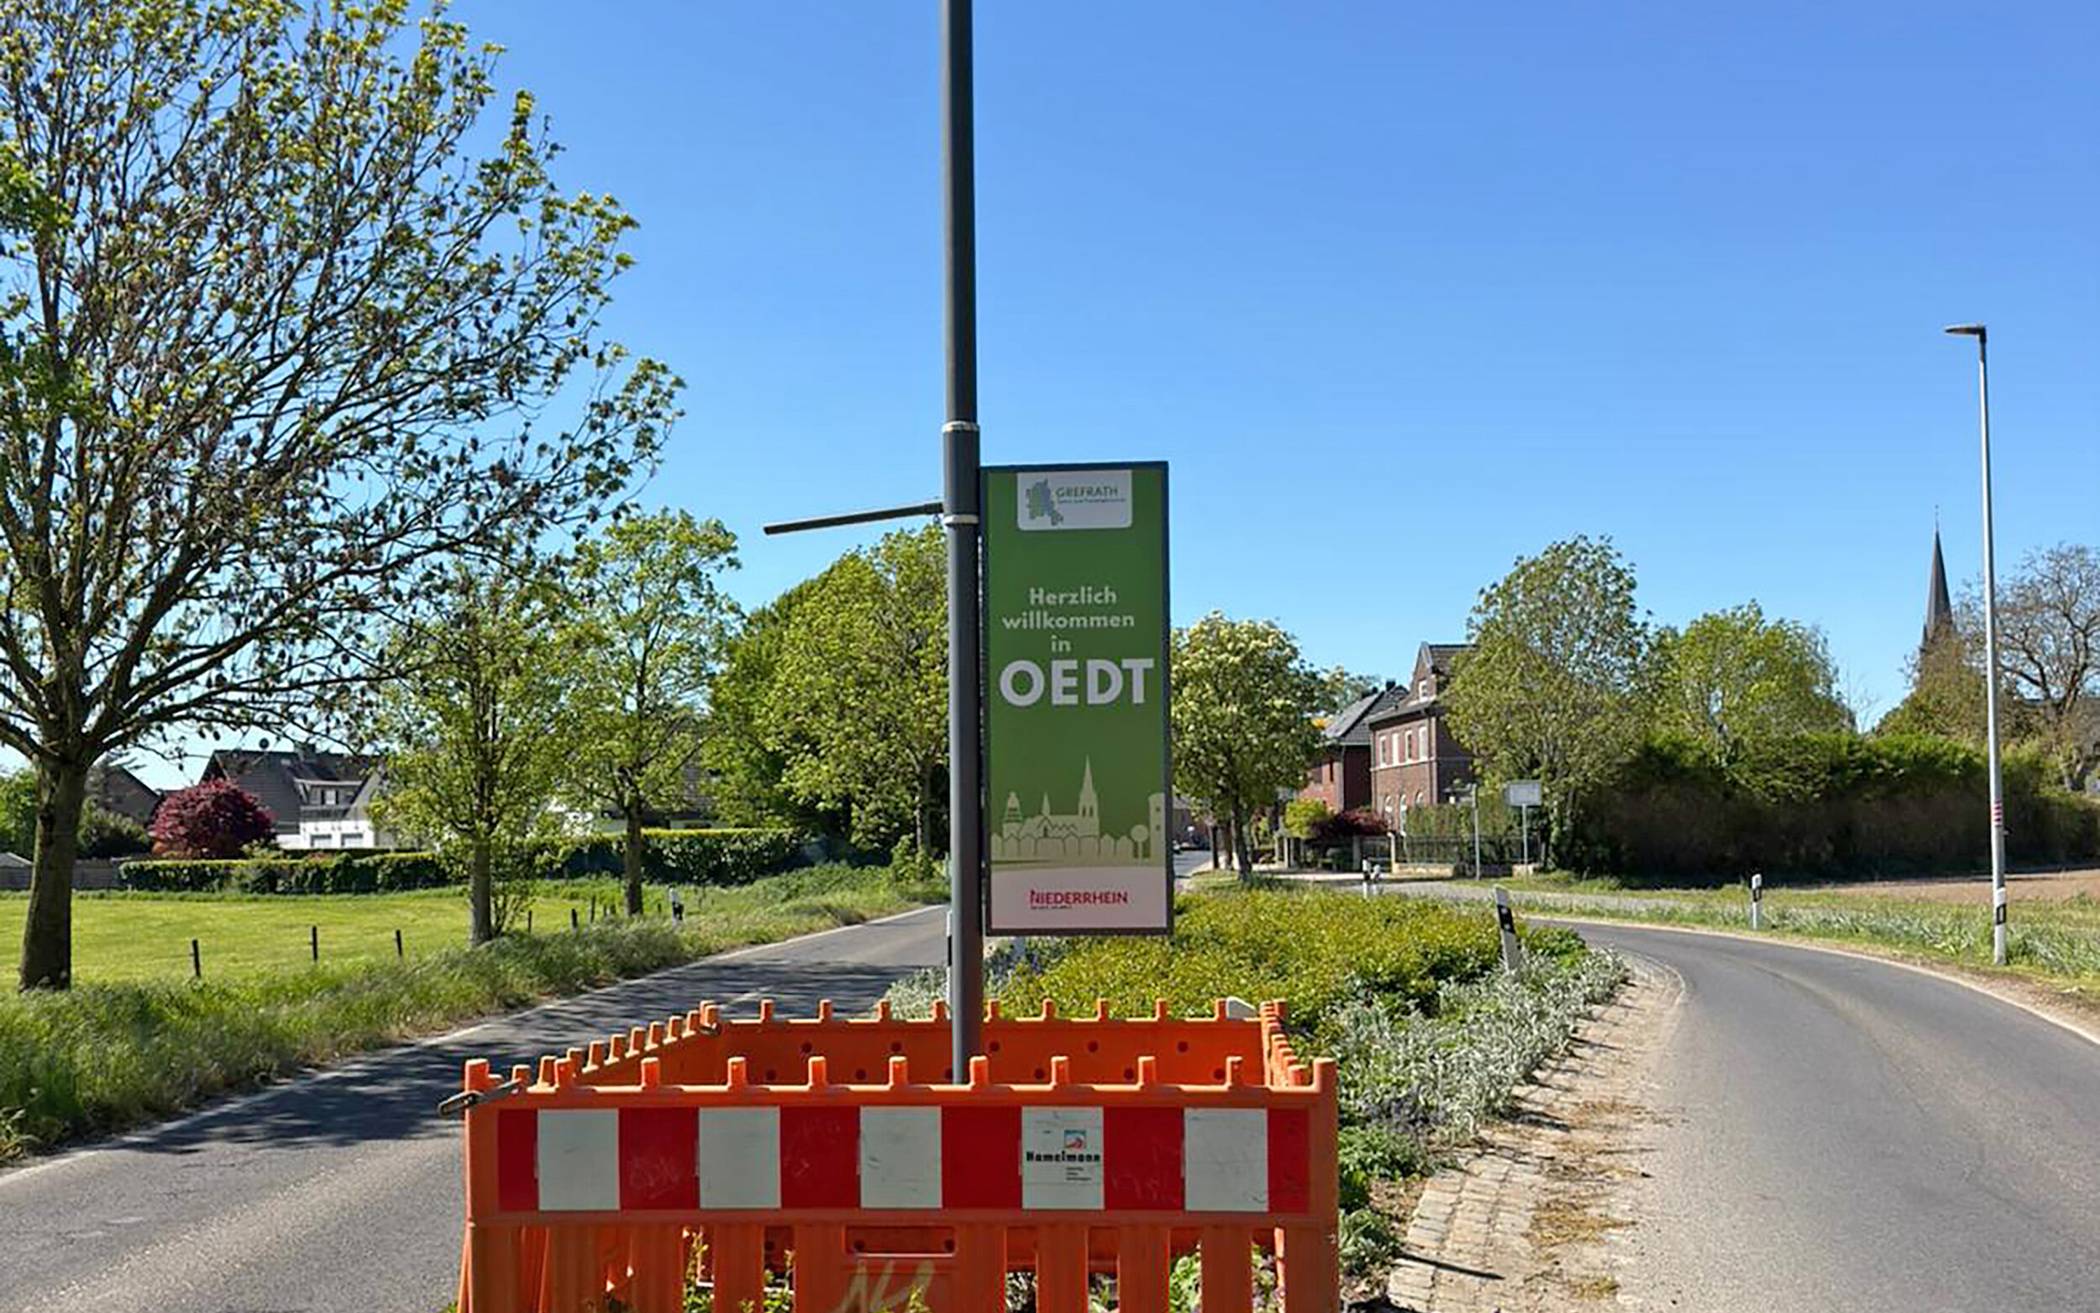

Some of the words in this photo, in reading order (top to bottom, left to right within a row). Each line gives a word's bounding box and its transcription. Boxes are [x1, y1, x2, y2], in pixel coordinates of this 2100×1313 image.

[1056, 486, 1118, 498] GREFRATH
[1029, 585, 1117, 605] Herzlich
[1002, 610, 1135, 629] willkommen
[1050, 635, 1071, 652] in
[999, 658, 1154, 707] OEDT
[1029, 889, 1128, 905] NIEDERRHEIN
